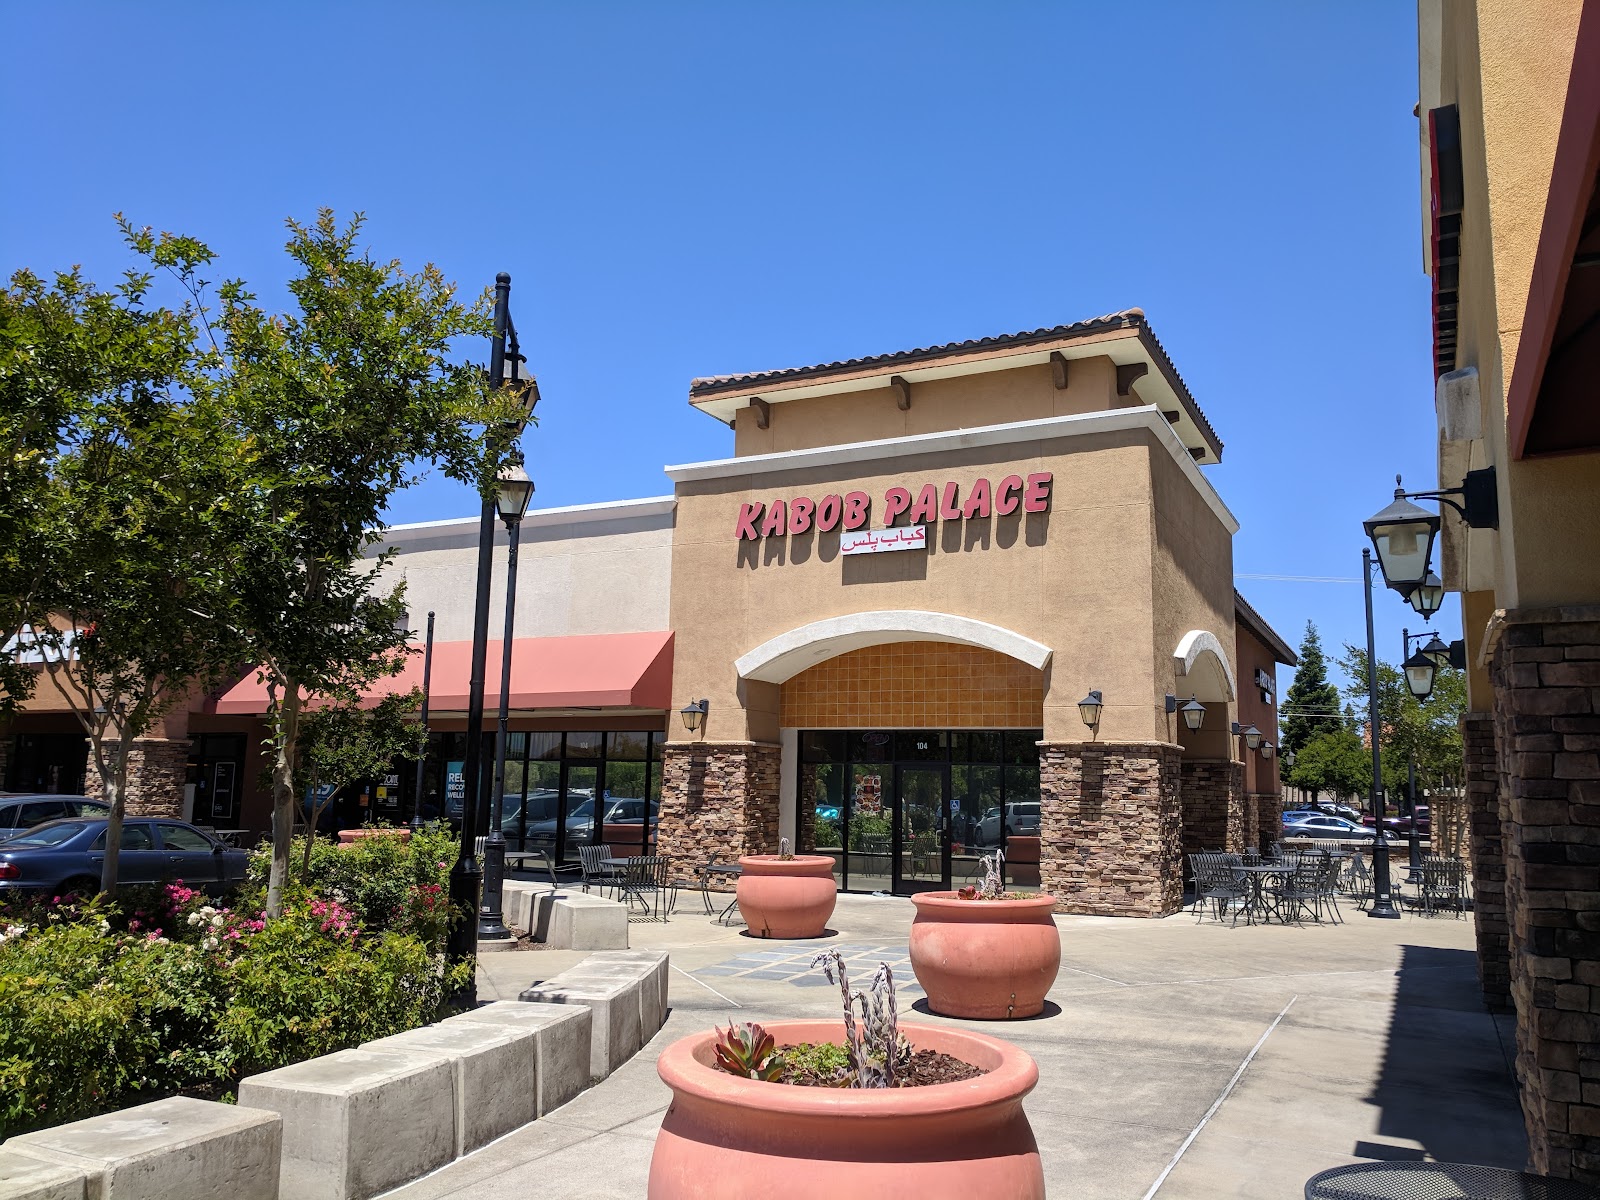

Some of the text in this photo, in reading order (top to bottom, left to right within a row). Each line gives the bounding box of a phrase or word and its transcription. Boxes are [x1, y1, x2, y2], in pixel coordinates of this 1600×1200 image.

[735, 471, 1053, 541] KABOB PALACE
[881, 528, 925, 547] کباب
[916, 742, 928, 750] 104
[448, 772, 465, 783] REL
[447, 783, 465, 791] RECO
